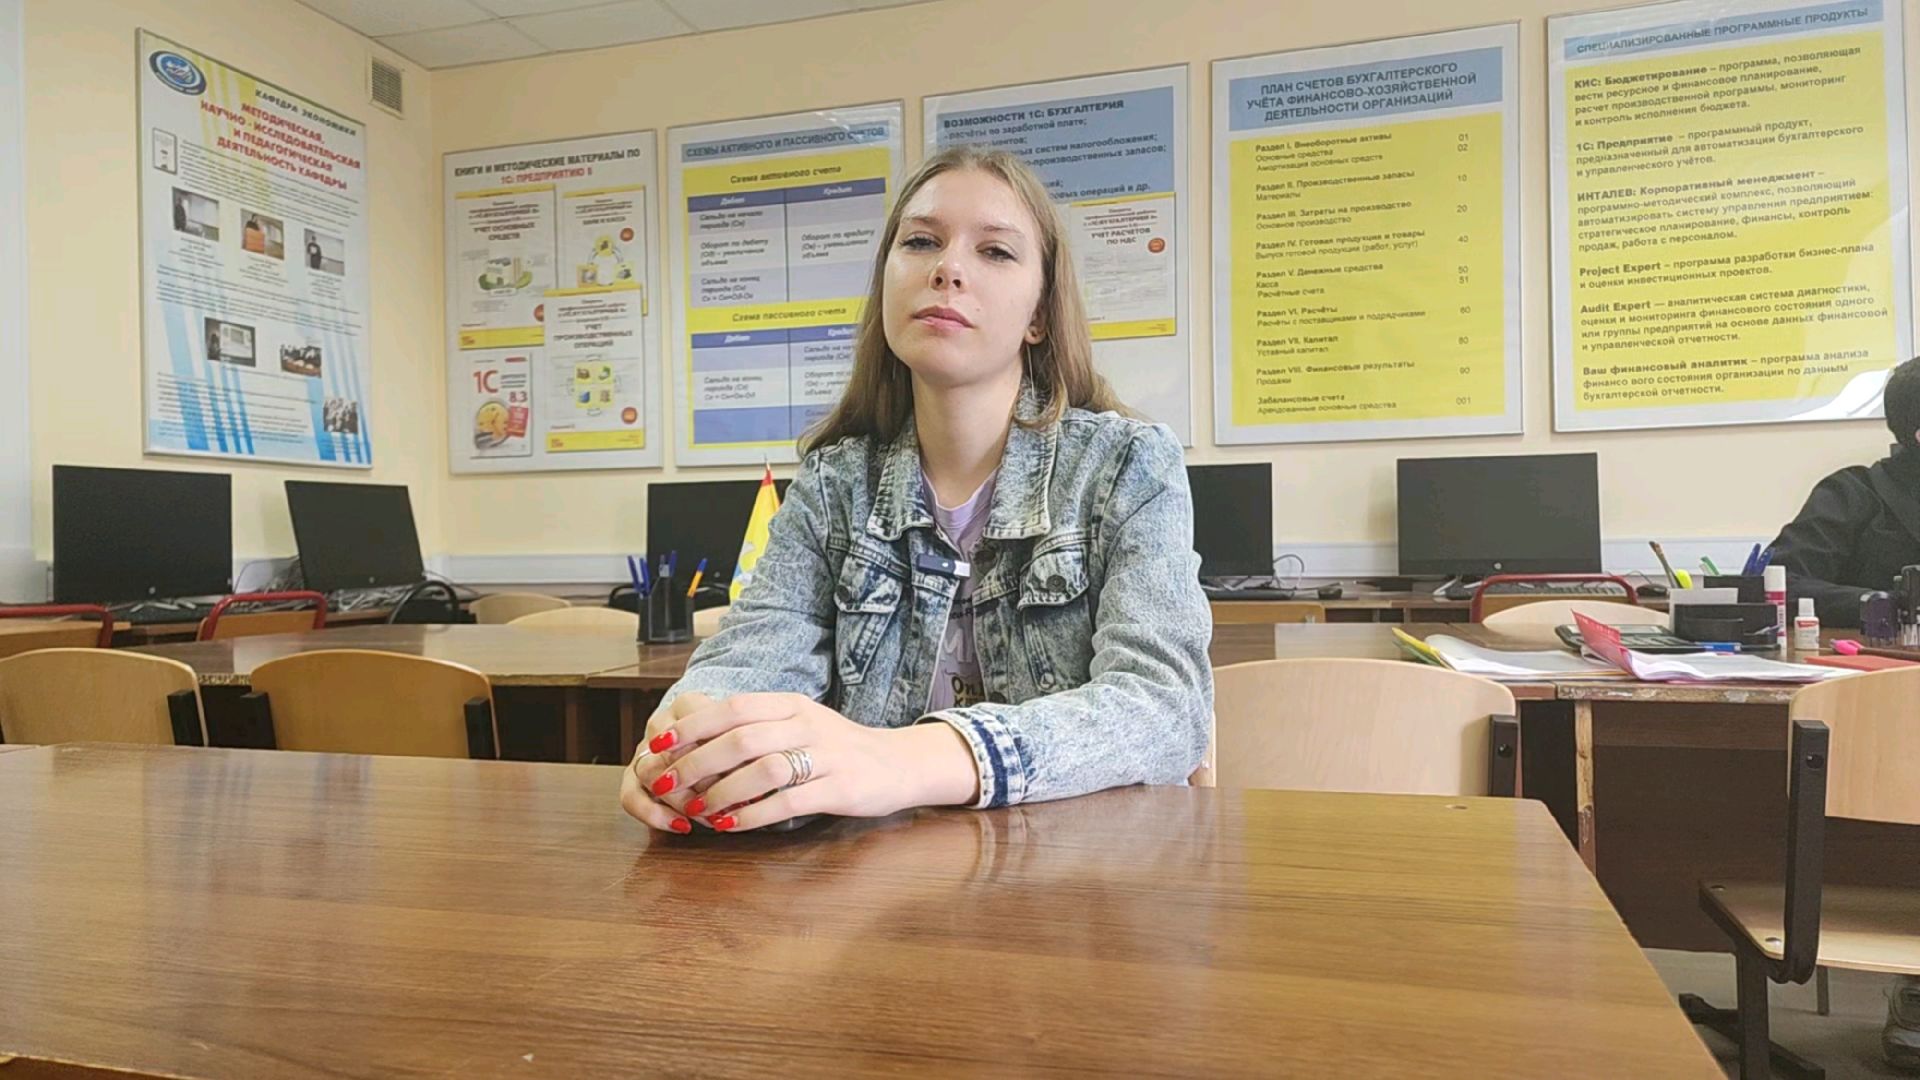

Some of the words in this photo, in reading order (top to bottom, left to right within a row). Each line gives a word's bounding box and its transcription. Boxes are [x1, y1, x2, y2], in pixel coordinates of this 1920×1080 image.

[1577, 29, 1711, 54] СПЕЦИАЛИЗИРОВАННЫЕ
[1714, 17, 1801, 35] ПРОГРАММНЫЕ
[1805, 9, 1868, 24] ПРОДУКТЫ
[1261, 83, 1293, 95] ПЛАН
[1296, 77, 1344, 91] СЧЕТОВ
[1346, 63, 1458, 84] БУХГАЛТЕРСКОГО
[1604, 68, 1707, 85] Бюджетирование
[1784, 48, 1861, 63] позволяющая
[1247, 97, 1284, 109] УЧЁТА
[1287, 73, 1476, 104] ФИНАНСОВО-ХОЗЯЙСТВЕННОЙ
[1574, 93, 1604, 102] вести
[1606, 86, 1660, 99] ресурсное
[1671, 76, 1738, 91] финансовое
[1575, 104, 1609, 116] расчет
[1611, 91, 1710, 110] производственной
[1780, 76, 1846, 90] мониторинг
[943, 112, 1025, 128] ВОЗМОЖНОСТИ
[1047, 100, 1124, 116] БУХГАЛТЕРИЯ
[1264, 102, 1359, 121] ДЕЯТЕЛЬНОСТИ
[1362, 90, 1453, 110] ОРГАНИЗАЦИЙ
[1584, 115, 1632, 125] контроль
[1634, 107, 1697, 120] исполнения
[949, 130, 987, 140] расчёты
[1002, 120, 1055, 134] заработной
[1597, 136, 1673, 150] Предприятие
[1688, 124, 1762, 140] программный
[1035, 144, 1068, 154] систем
[1576, 146, 1669, 165] предназначенный
[1671, 146, 1692, 155] для
[1694, 137, 1775, 152] автоматизации
[1778, 127, 1864, 144] бухгалтерского
[454, 166, 483, 177] КНИГИ
[485, 165, 492, 173] И
[494, 157, 565, 172] МЕТОДИЧЕСКИЕ
[567, 151, 625, 164] МАТЕРИАЛЫ
[627, 148, 640, 158] ПО
[1080, 184, 1125, 196] операций
[1640, 178, 1733, 195] Корпоративный
[1737, 171, 1815, 185] менеджмент
[1578, 226, 1656, 240] стратегическое
[1798, 208, 1851, 218] контроль
[1622, 238, 1658, 250] работа
[1660, 237, 1667, 245] с
[1579, 266, 1620, 277] Project
[1623, 262, 1661, 273] Expert
[1673, 257, 1731, 269] программа
[1734, 252, 1796, 264] разработки
[1799, 245, 1874, 257] бизнес-плана
[1588, 280, 1624, 288] оценки
[1627, 272, 1716, 285] инвестиционных
[1580, 304, 1610, 313] Audit
[1613, 301, 1651, 312] Expert
[1668, 294, 1747, 307] аналитическая
[1750, 290, 1794, 300] система
[1583, 367, 1607, 375] Ваш
[1610, 361, 1687, 375] финансовый
[1691, 359, 1748, 369] аналитик
[1760, 354, 1820, 365] программа
[1824, 350, 1868, 360] анализа
[473, 370, 499, 393] 1С
